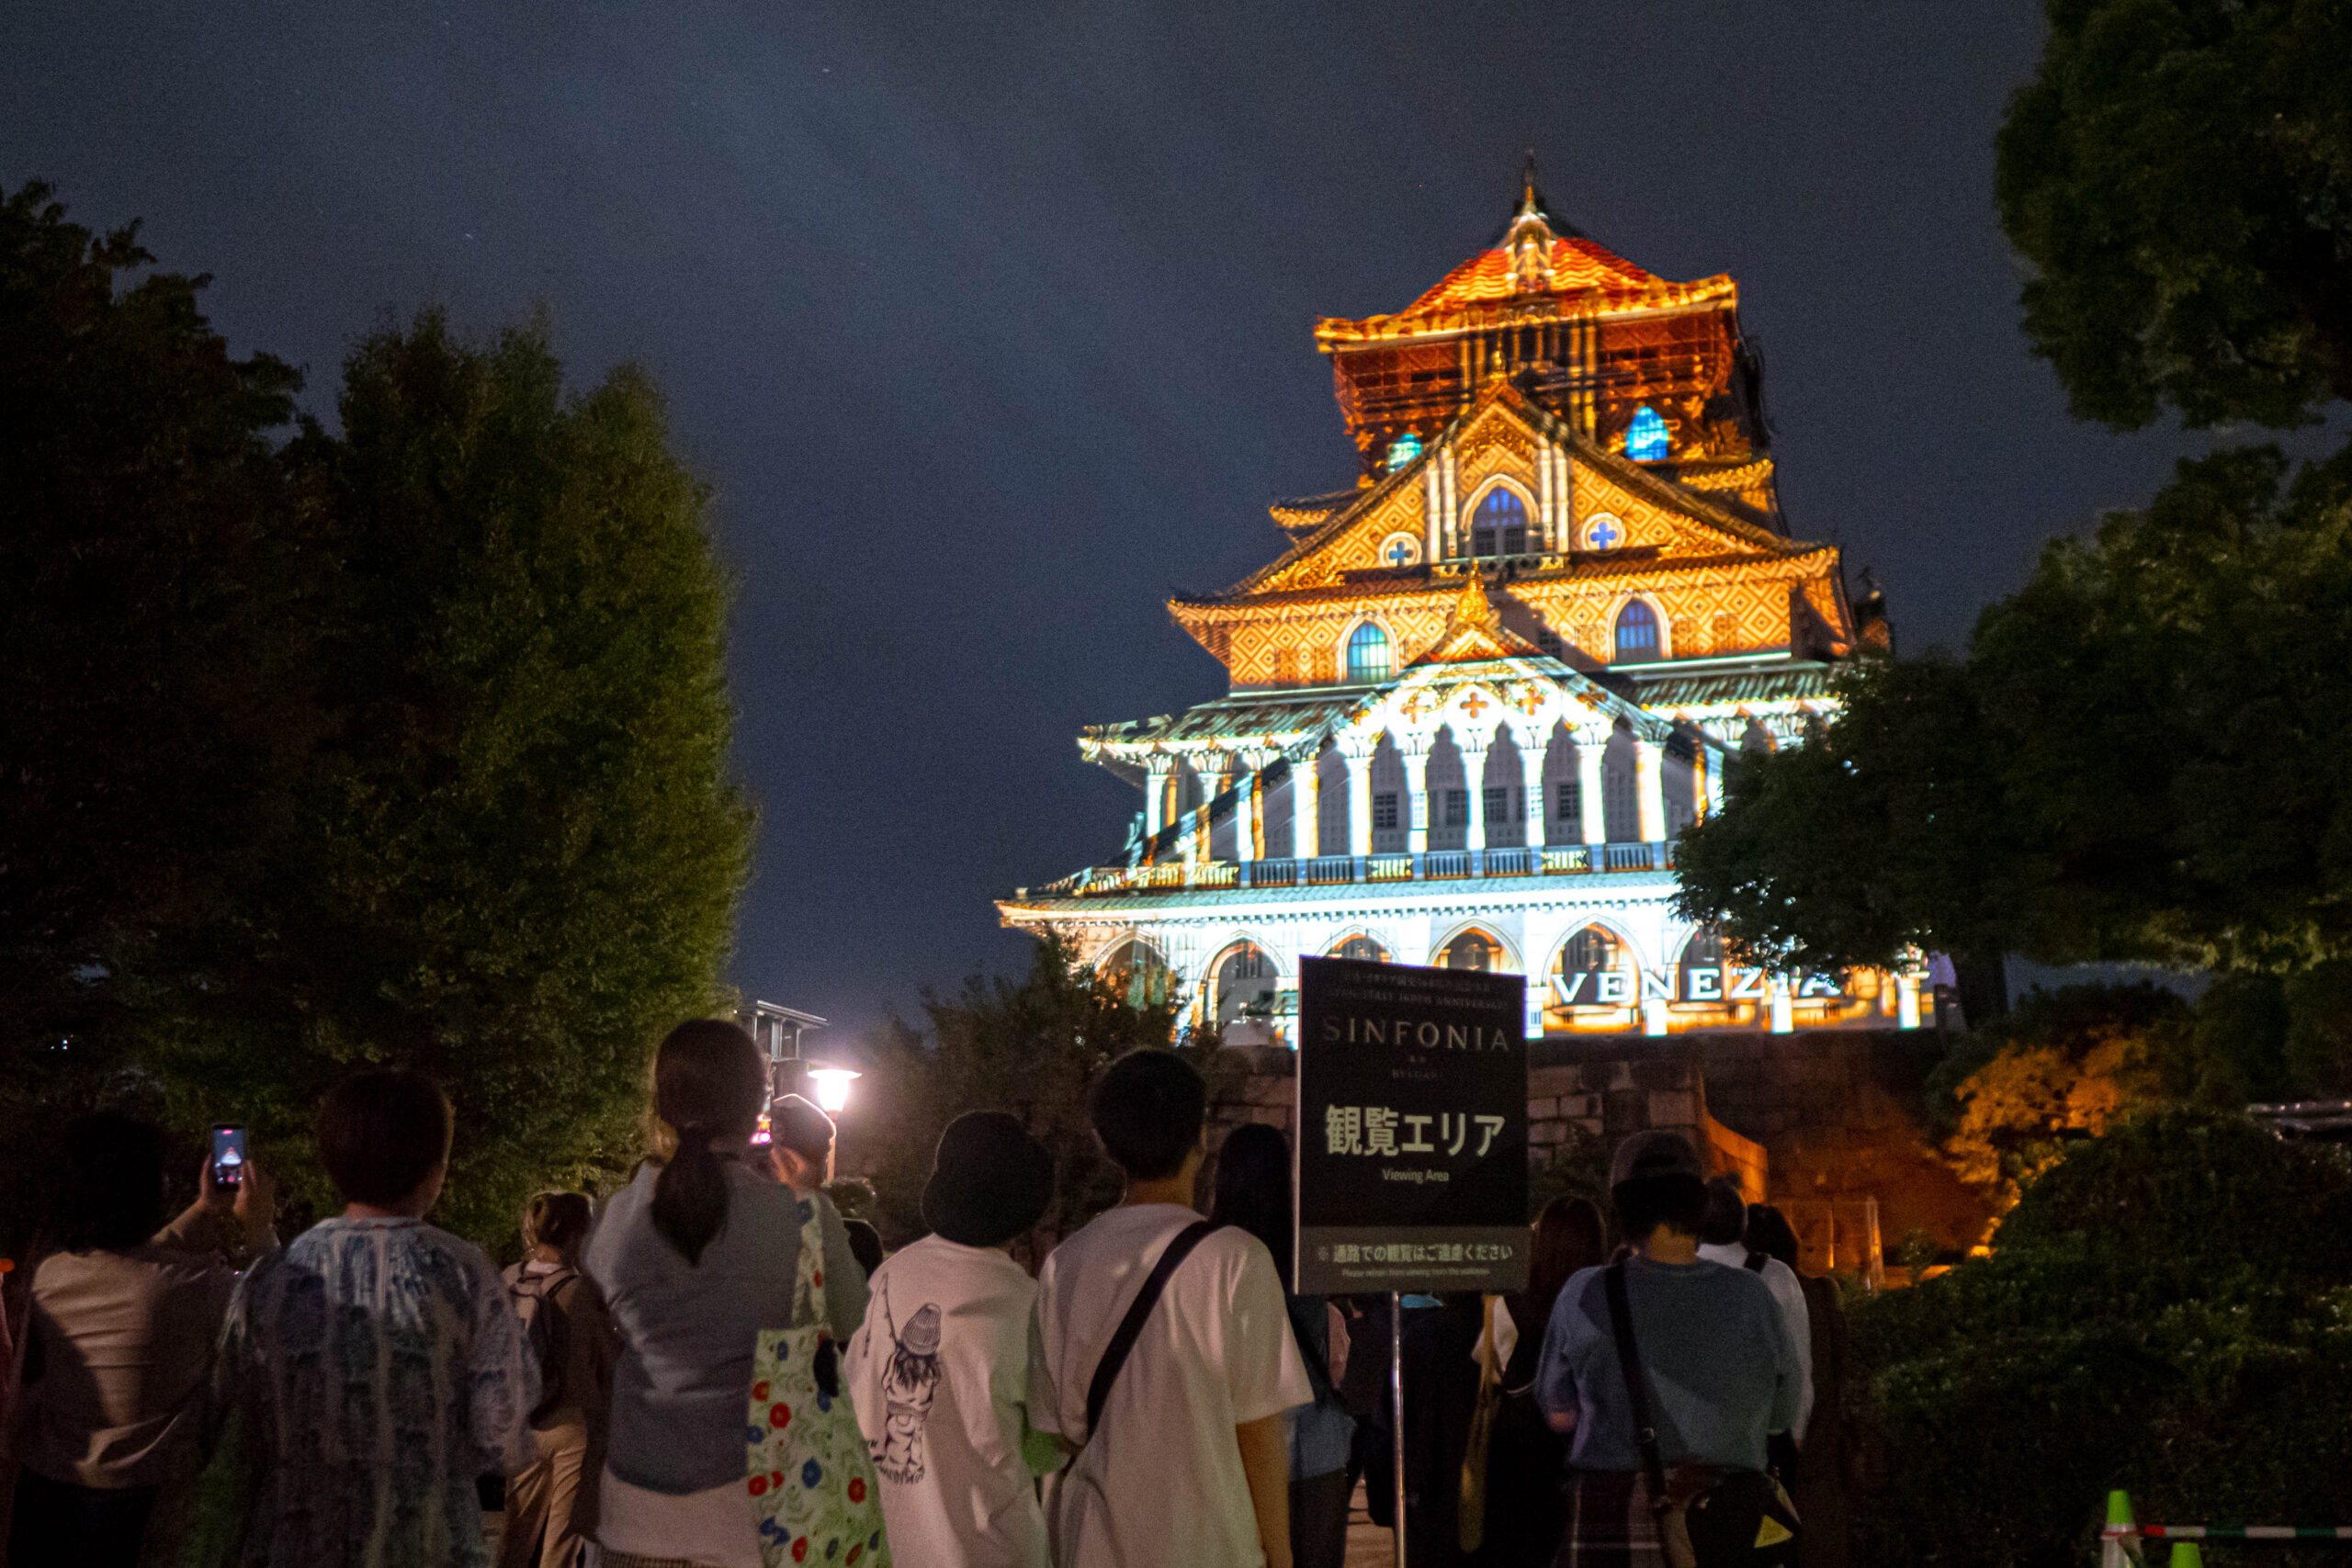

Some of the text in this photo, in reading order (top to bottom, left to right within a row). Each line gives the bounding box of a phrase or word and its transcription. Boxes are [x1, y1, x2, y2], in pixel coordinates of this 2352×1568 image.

[1322, 1015, 1510, 1052] SINFONIA
[1326, 1104, 1506, 1157] 観覧エリア
[1383, 1168, 1450, 1185] Viewing Area
